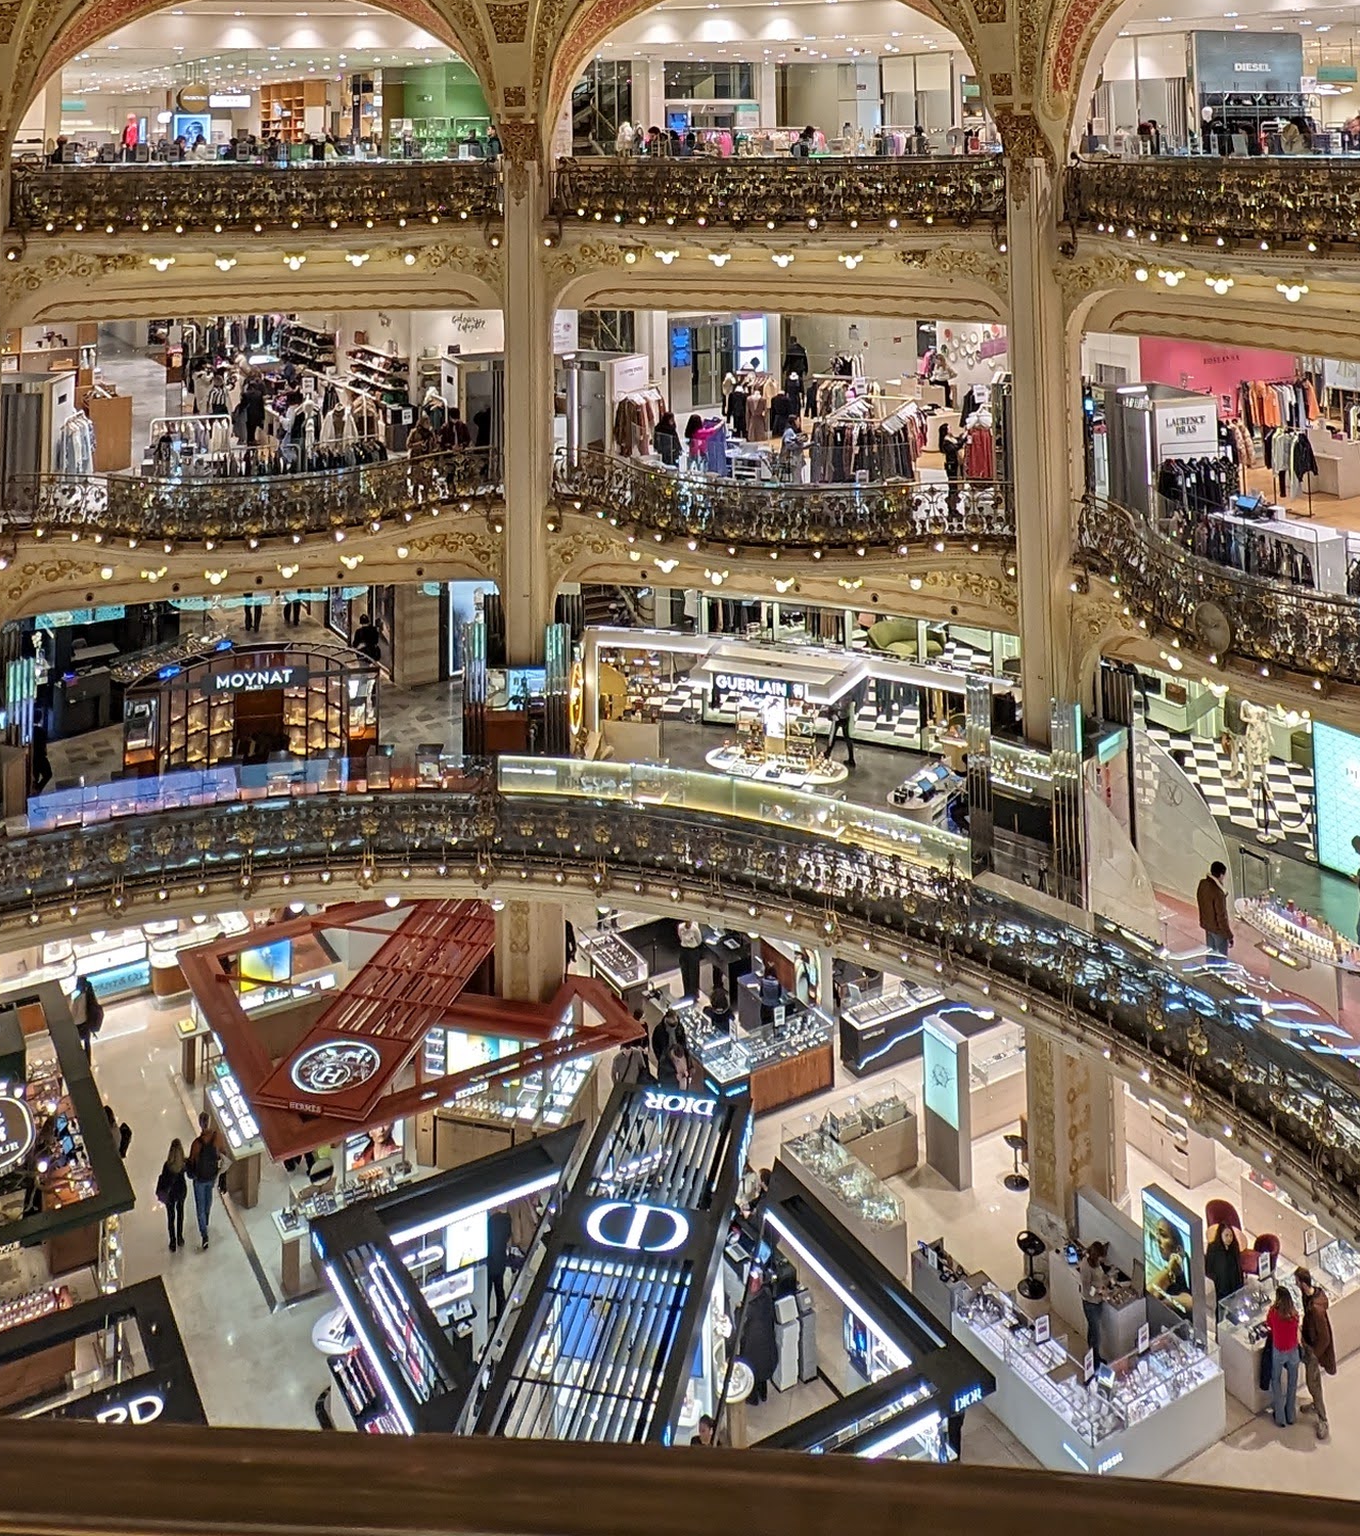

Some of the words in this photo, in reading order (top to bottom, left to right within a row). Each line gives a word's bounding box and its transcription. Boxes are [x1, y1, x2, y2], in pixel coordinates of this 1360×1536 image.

[1234, 62, 1271, 73] DIESEL
[1165, 415, 1206, 428] LAURENCE
[1176, 425, 1197, 436] BRAS
[216, 669, 293, 690] MOYNAT
[715, 674, 787, 697] GUERLAIN
[644, 1091, 718, 1117] DIOR
[954, 1387, 983, 1413] DIOR
[1097, 1451, 1124, 1476] FOSSIL
